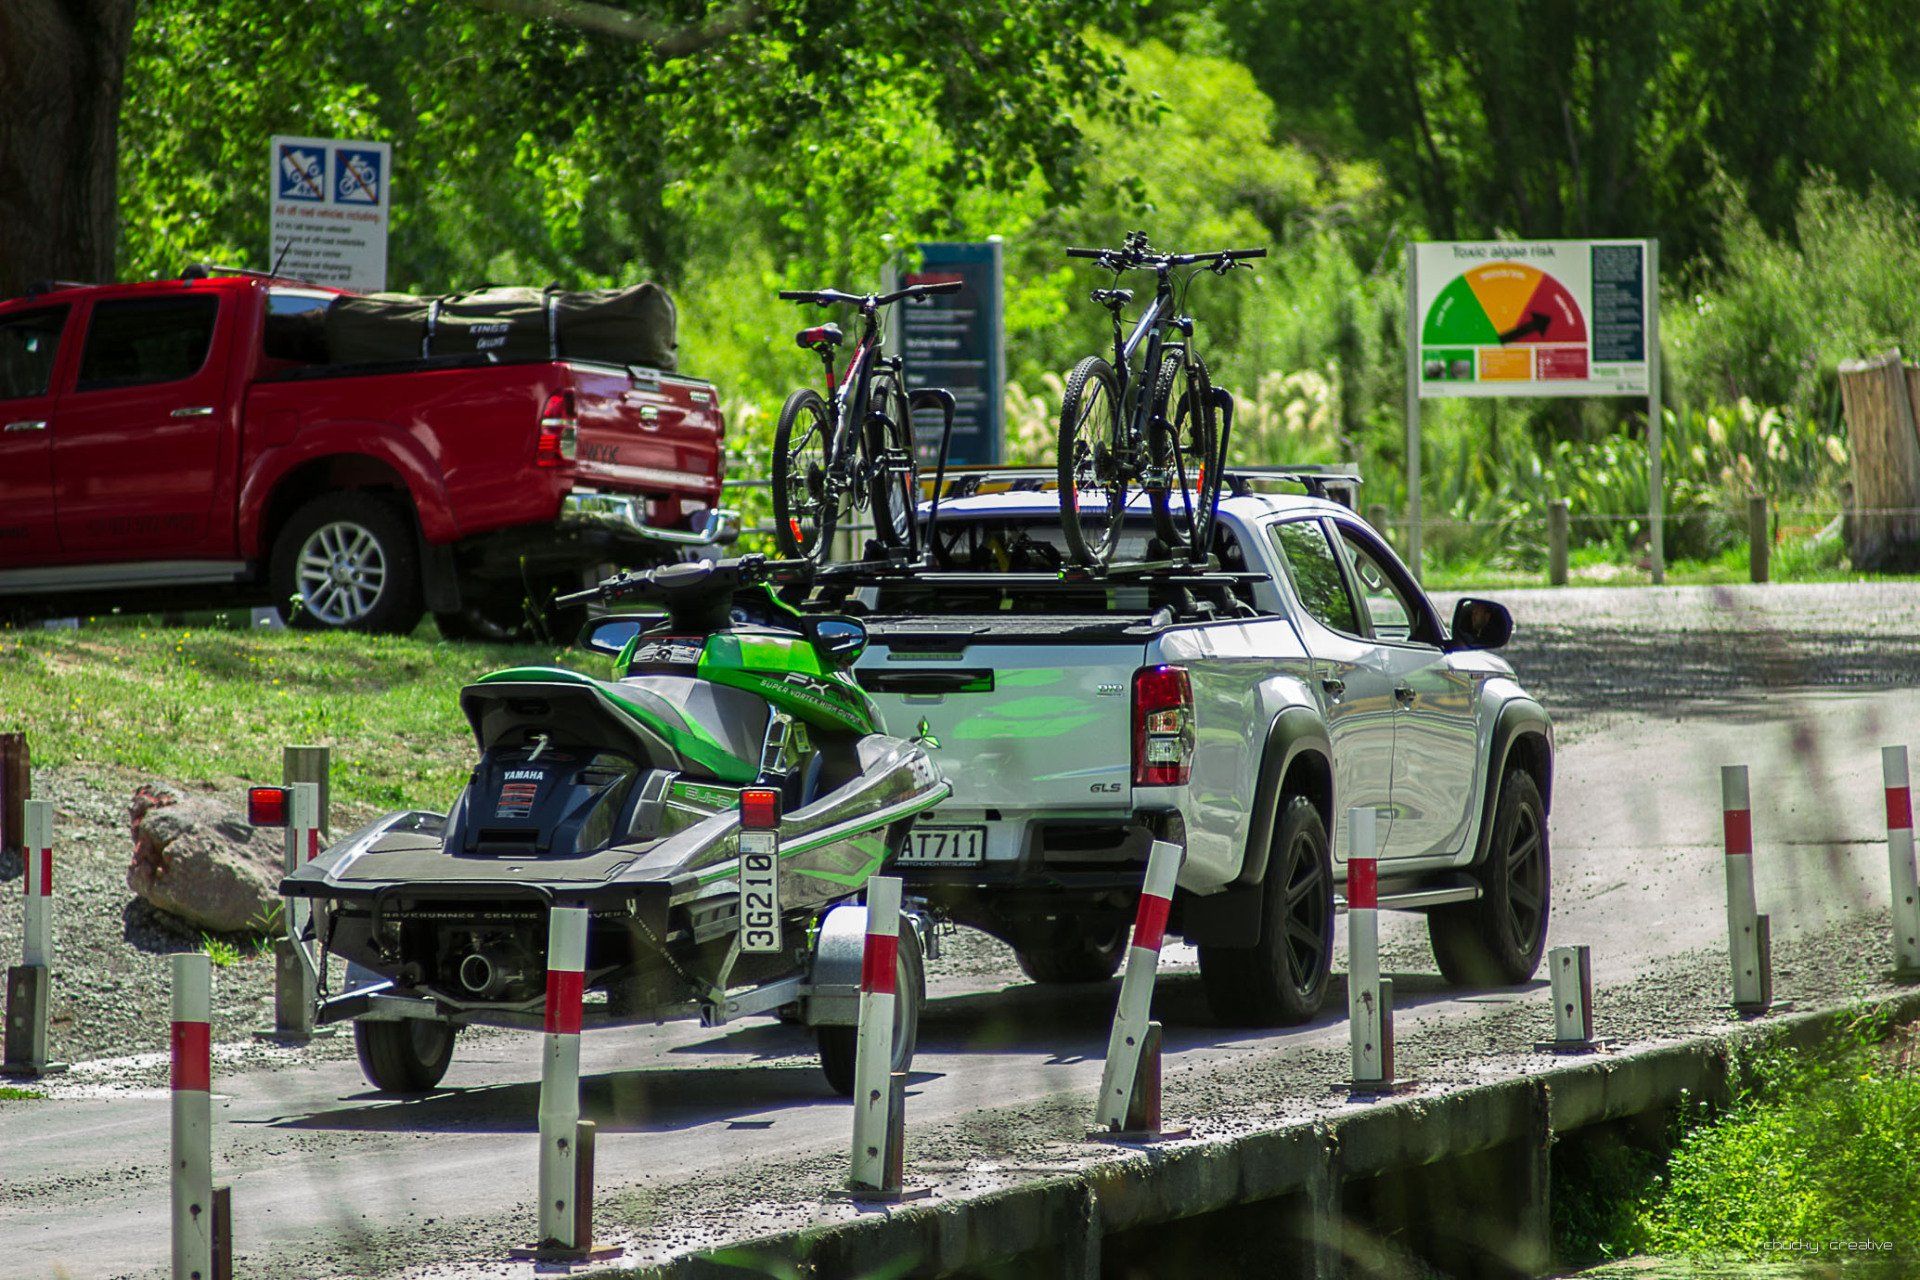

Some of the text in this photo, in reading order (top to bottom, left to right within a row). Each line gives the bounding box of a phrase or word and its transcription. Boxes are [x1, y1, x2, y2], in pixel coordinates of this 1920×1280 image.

[1453, 245, 1556, 261] Toxic algae risk
[469, 324, 510, 334] KINGS
[783, 671, 831, 696] FX
[760, 680, 787, 694] SUPER
[790, 689, 818, 705] VORTEX
[504, 771, 544, 780] YAMAHA
[1090, 783, 1122, 793] GLS
[746, 855, 774, 947] 3G210
